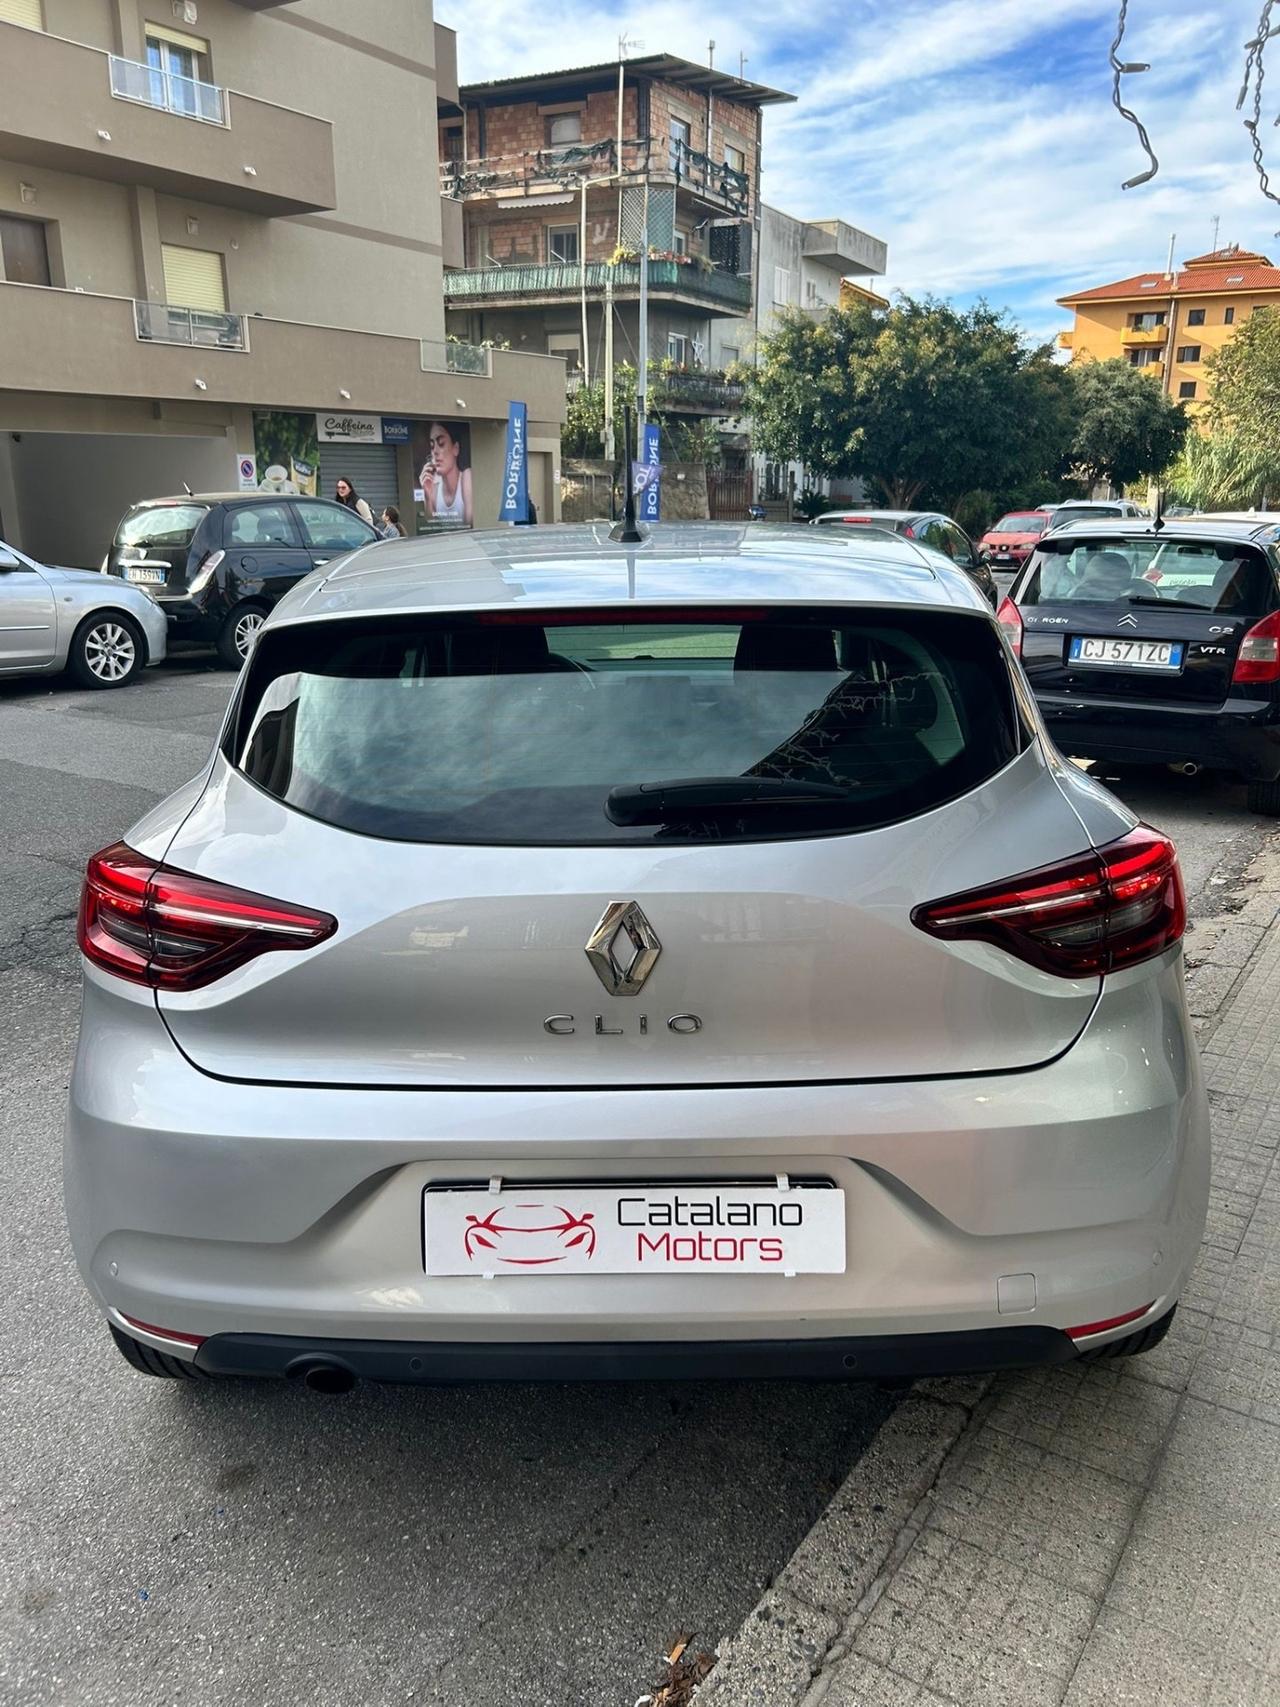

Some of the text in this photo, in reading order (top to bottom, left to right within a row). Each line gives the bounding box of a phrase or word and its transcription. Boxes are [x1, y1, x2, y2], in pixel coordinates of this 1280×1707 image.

[324, 417, 375, 432] Caffeina
[1208, 626, 1235, 636] C2
[1083, 640, 1107, 658] CJ
[1200, 646, 1226, 655] VTR
[543, 1012, 703, 1035] CLIO
[617, 1195, 803, 1227] Catalano
[637, 1231, 783, 1262] Motors
